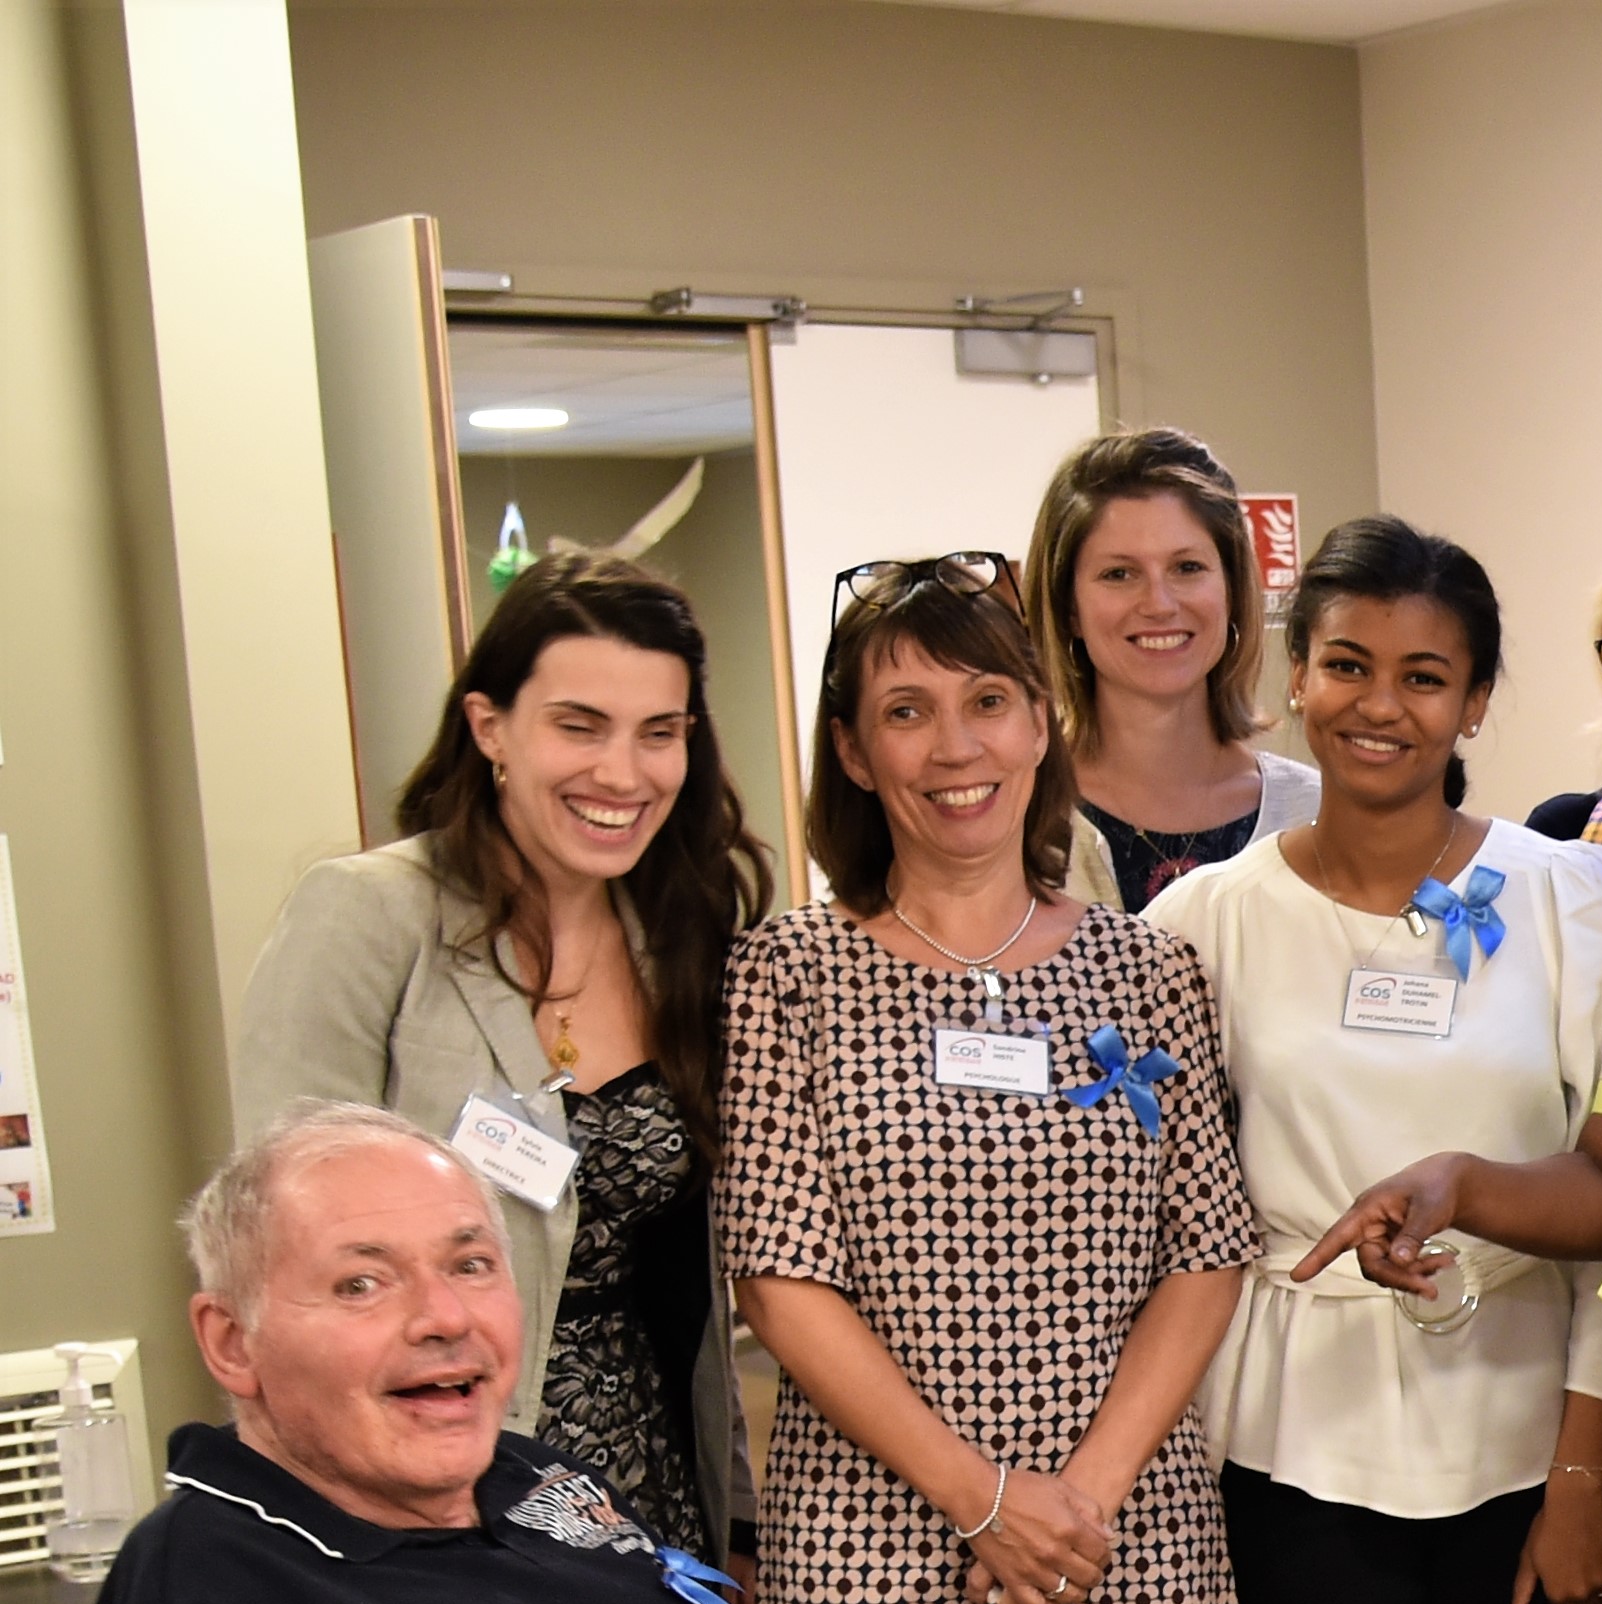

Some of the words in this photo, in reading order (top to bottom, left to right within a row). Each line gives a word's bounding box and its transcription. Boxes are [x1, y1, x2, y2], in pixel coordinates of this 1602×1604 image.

[1360, 986, 1391, 999] COS
[949, 1045, 981, 1058] COS
[475, 1120, 507, 1144] COS
